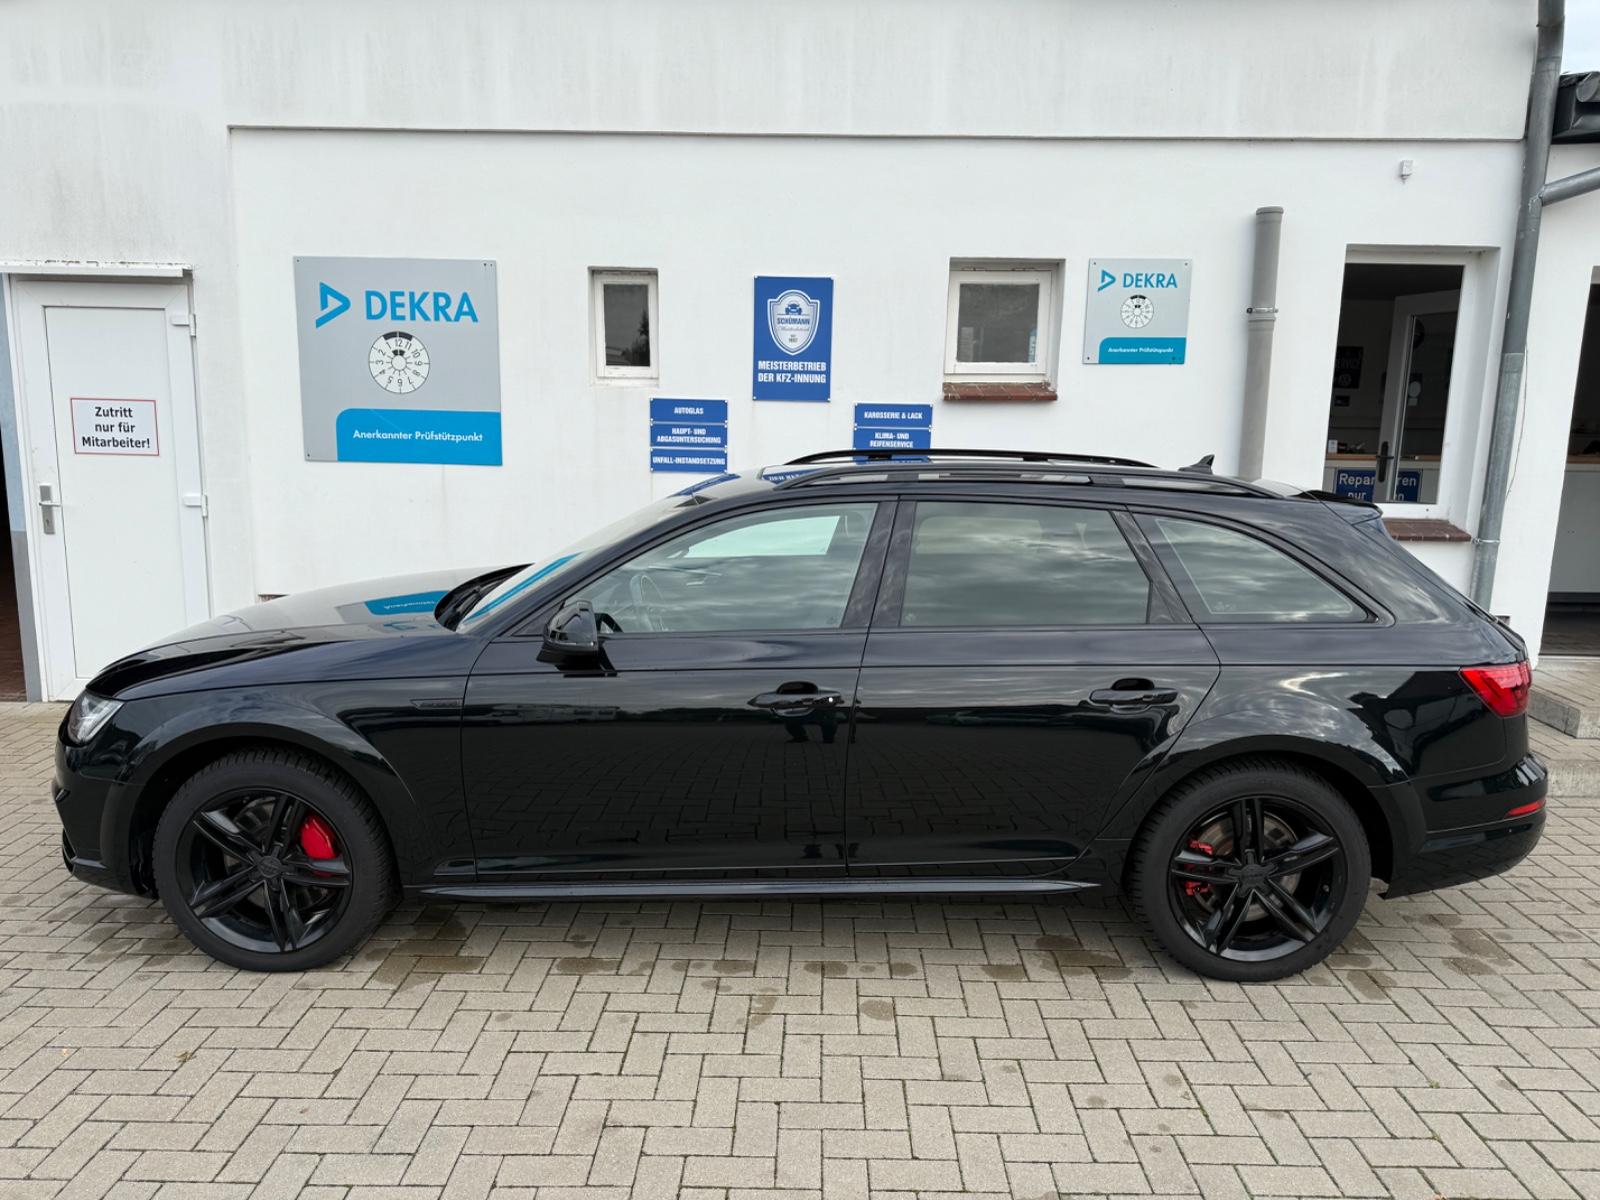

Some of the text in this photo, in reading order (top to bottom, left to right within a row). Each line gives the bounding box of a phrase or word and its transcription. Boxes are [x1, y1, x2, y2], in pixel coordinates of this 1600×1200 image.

[1123, 272, 1178, 288] DEKRA
[364, 290, 479, 323] DEKRA
[758, 361, 827, 372] MEISTERBETRIEB
[758, 373, 827, 384] DER KFZ-INNUNG
[94, 406, 134, 418] Zutritt
[673, 406, 704, 415] AUTOGLAS
[863, 411, 901, 419] KAROSSERIE
[907, 412, 923, 420] LACK
[94, 421, 136, 433] nur für
[693, 428, 707, 436] UND
[352, 428, 484, 443] Anerkannter Prüfstützpunkt
[896, 432, 910, 440] UND
[81, 436, 151, 449] Mitarbeiter!
[652, 456, 726, 465] UNFALL-INSTANDSETZUNG
